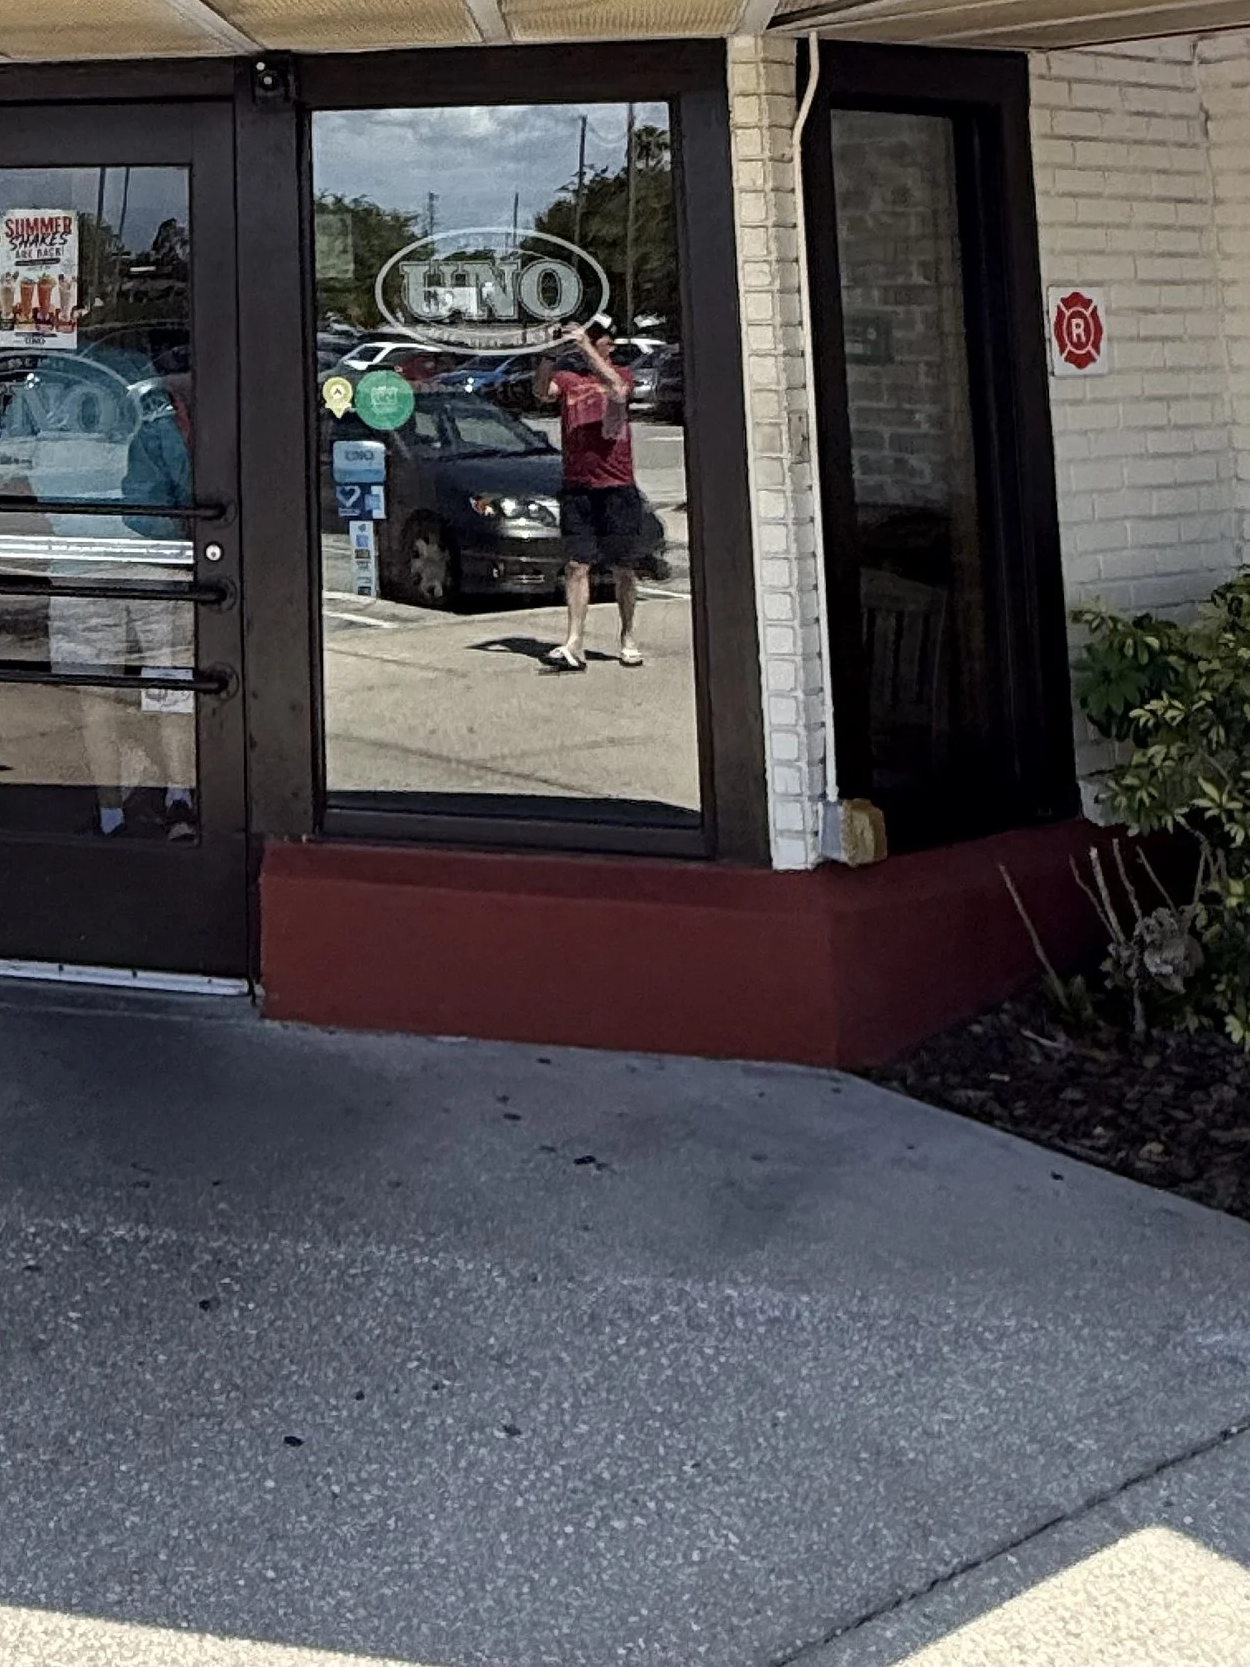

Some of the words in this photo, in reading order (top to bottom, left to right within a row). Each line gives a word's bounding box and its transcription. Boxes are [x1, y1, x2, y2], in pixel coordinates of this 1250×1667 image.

[5, 216, 72, 238] SUMMER
[9, 233, 67, 251] SHAKES
[400, 259, 583, 320] UNO
[1072, 319, 1086, 342] R
